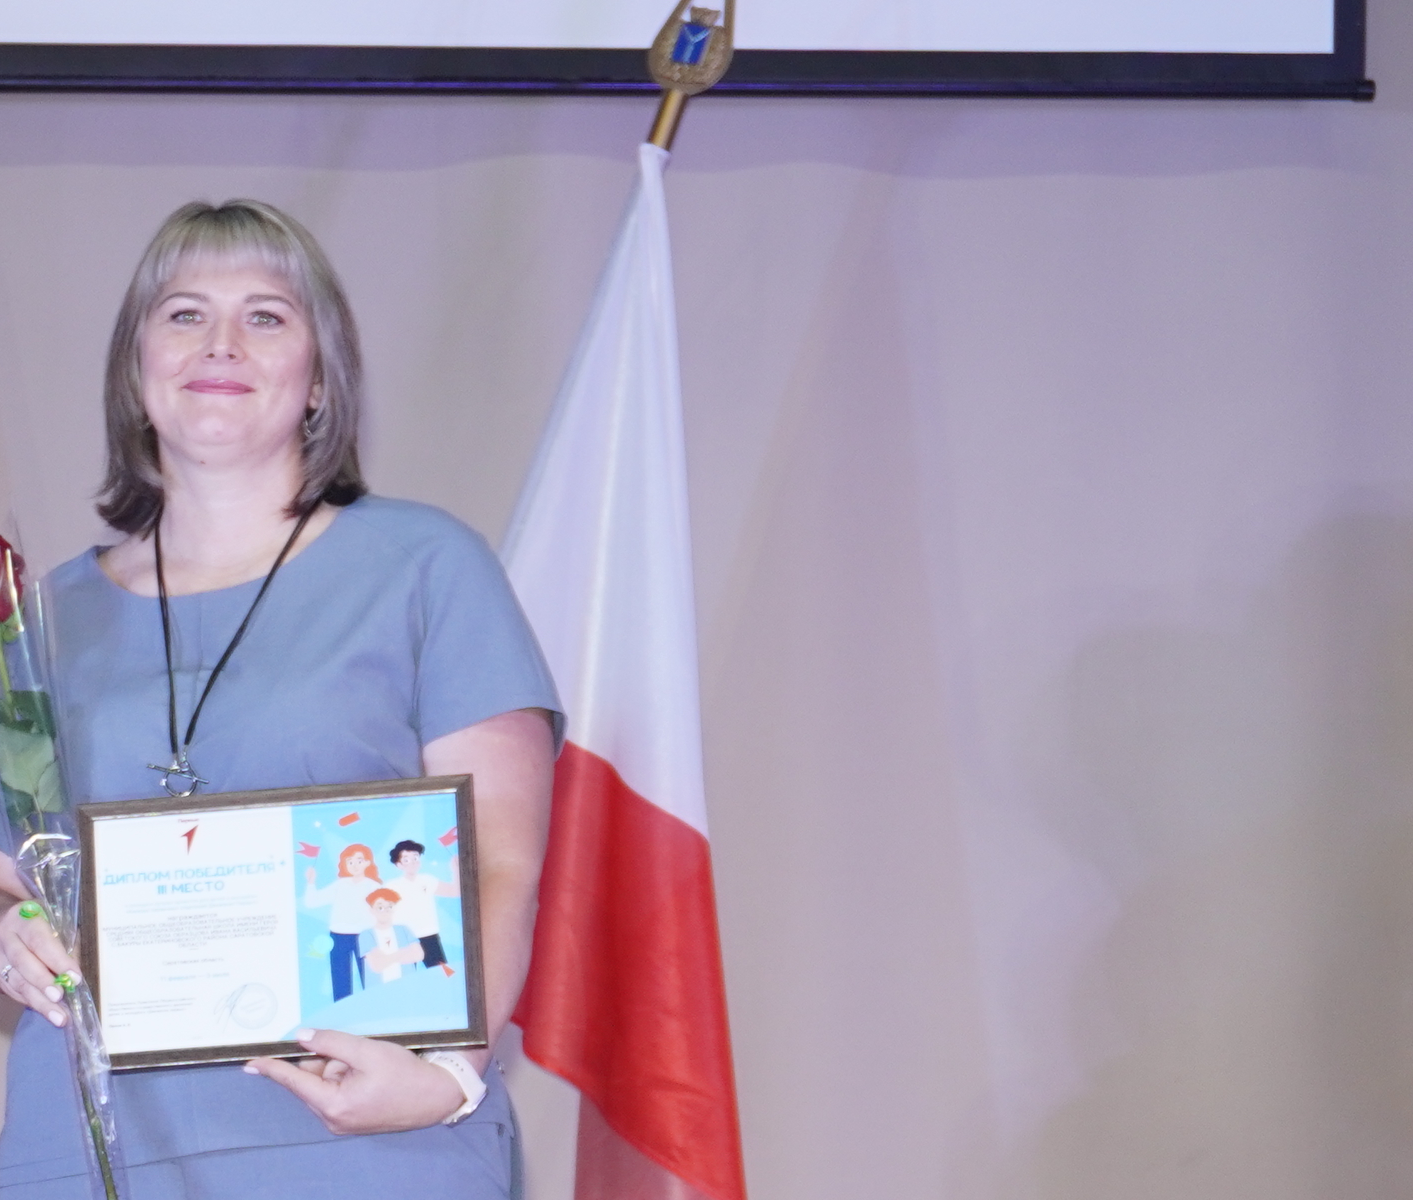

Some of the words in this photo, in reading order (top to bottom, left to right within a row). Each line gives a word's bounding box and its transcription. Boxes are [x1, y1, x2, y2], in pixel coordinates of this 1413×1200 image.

[103, 870, 171, 886] ДИПЛОМ
[174, 862, 276, 880] ПОБЕДИТЕЛЯ
[171, 880, 225, 894] МЕСТО
